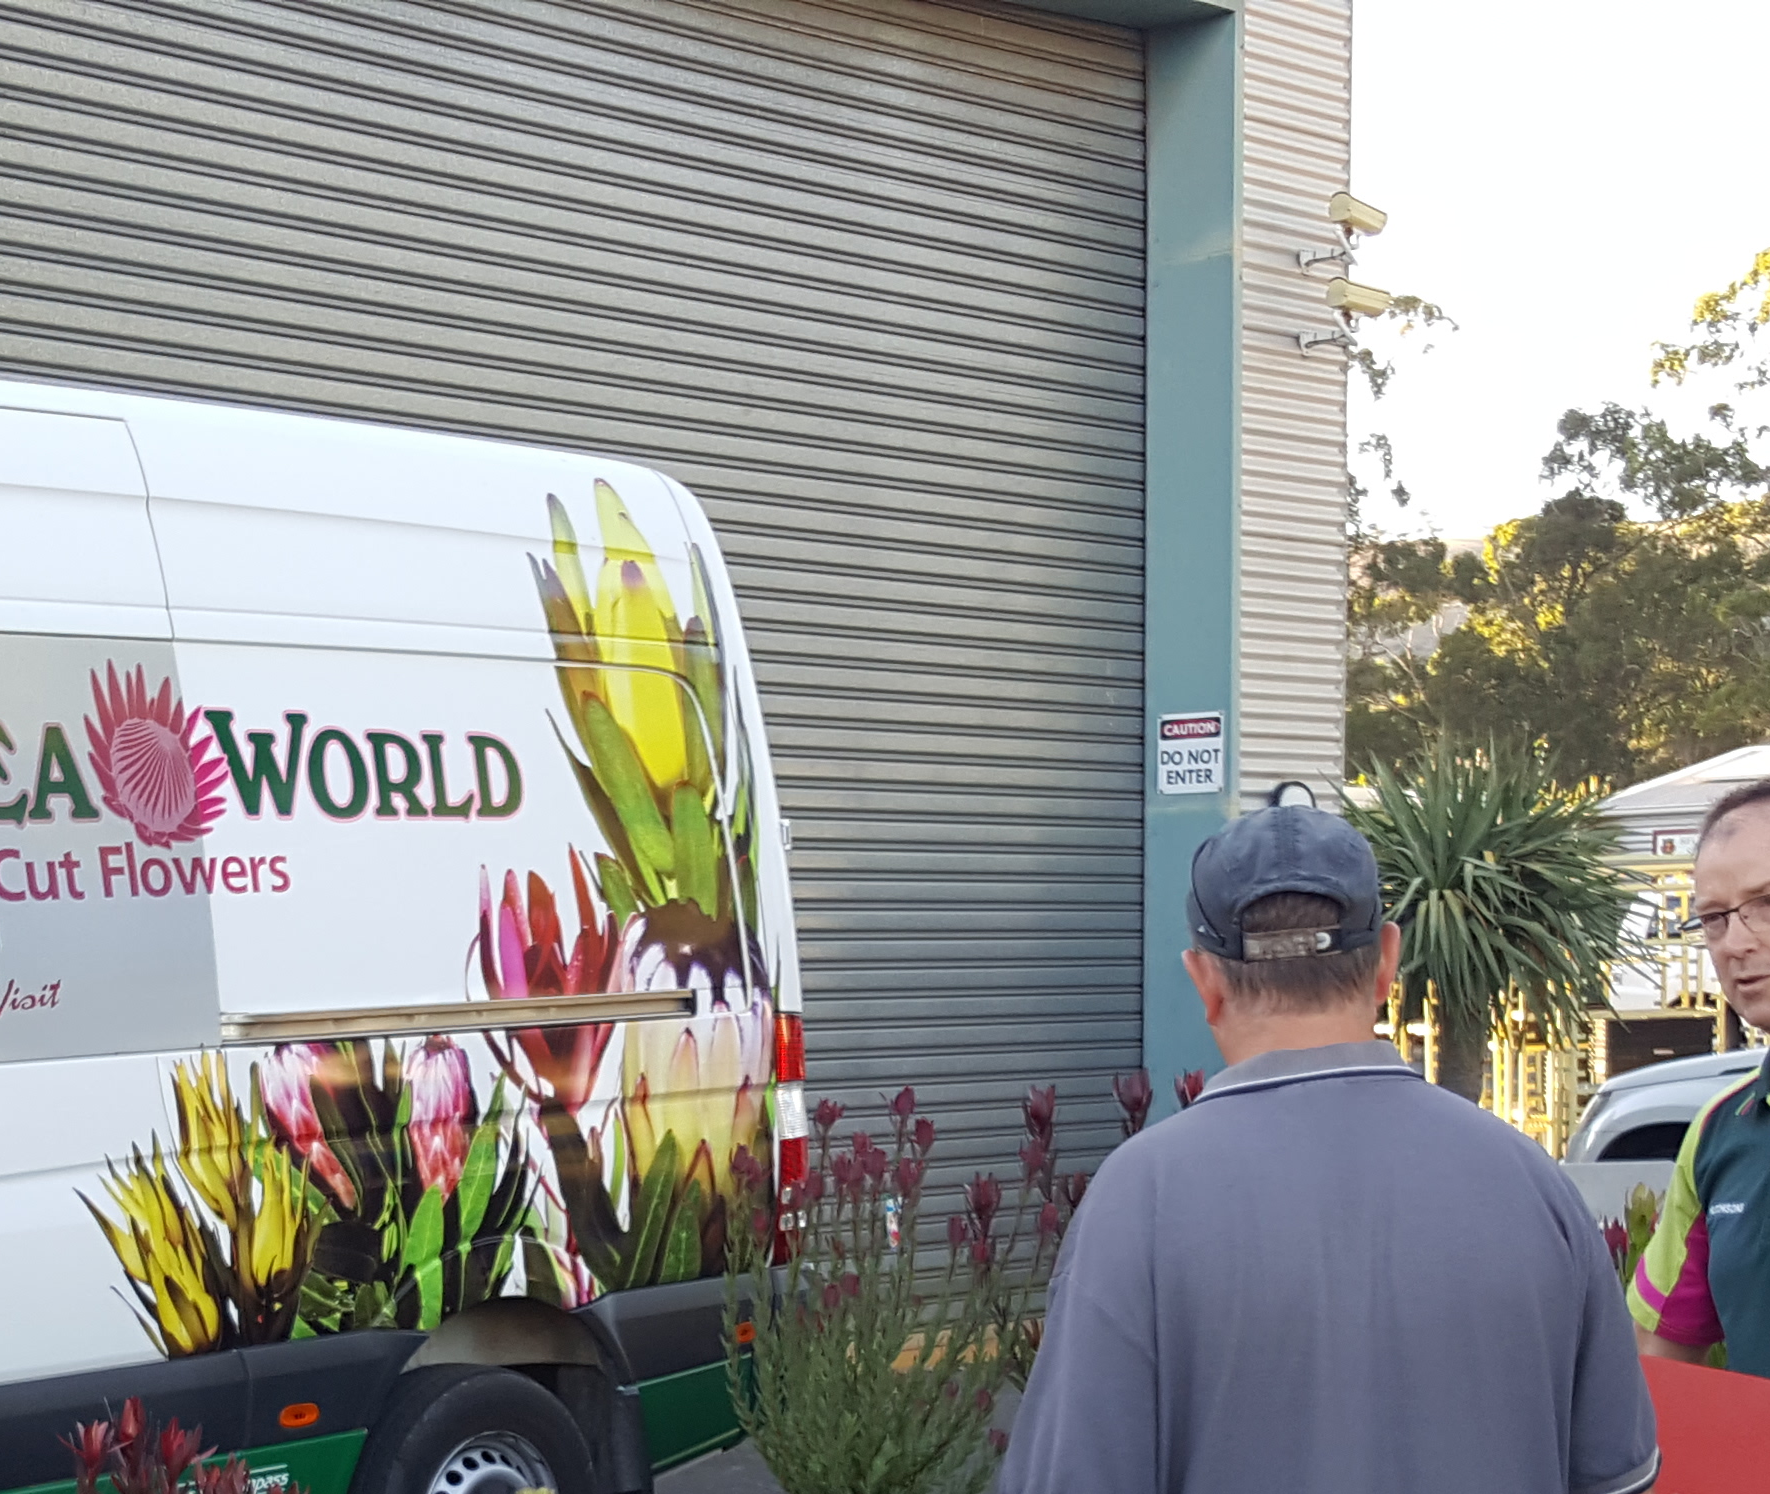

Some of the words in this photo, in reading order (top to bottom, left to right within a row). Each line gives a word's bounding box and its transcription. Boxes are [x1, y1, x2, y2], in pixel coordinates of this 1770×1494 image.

[1162, 720, 1217, 737] CAUTION
[203, 707, 524, 823] WORLD
[1161, 751, 1183, 766] DO
[1187, 749, 1221, 765] NOT
[1166, 769, 1214, 785] ENTER
[98, 841, 292, 898] Flowers
